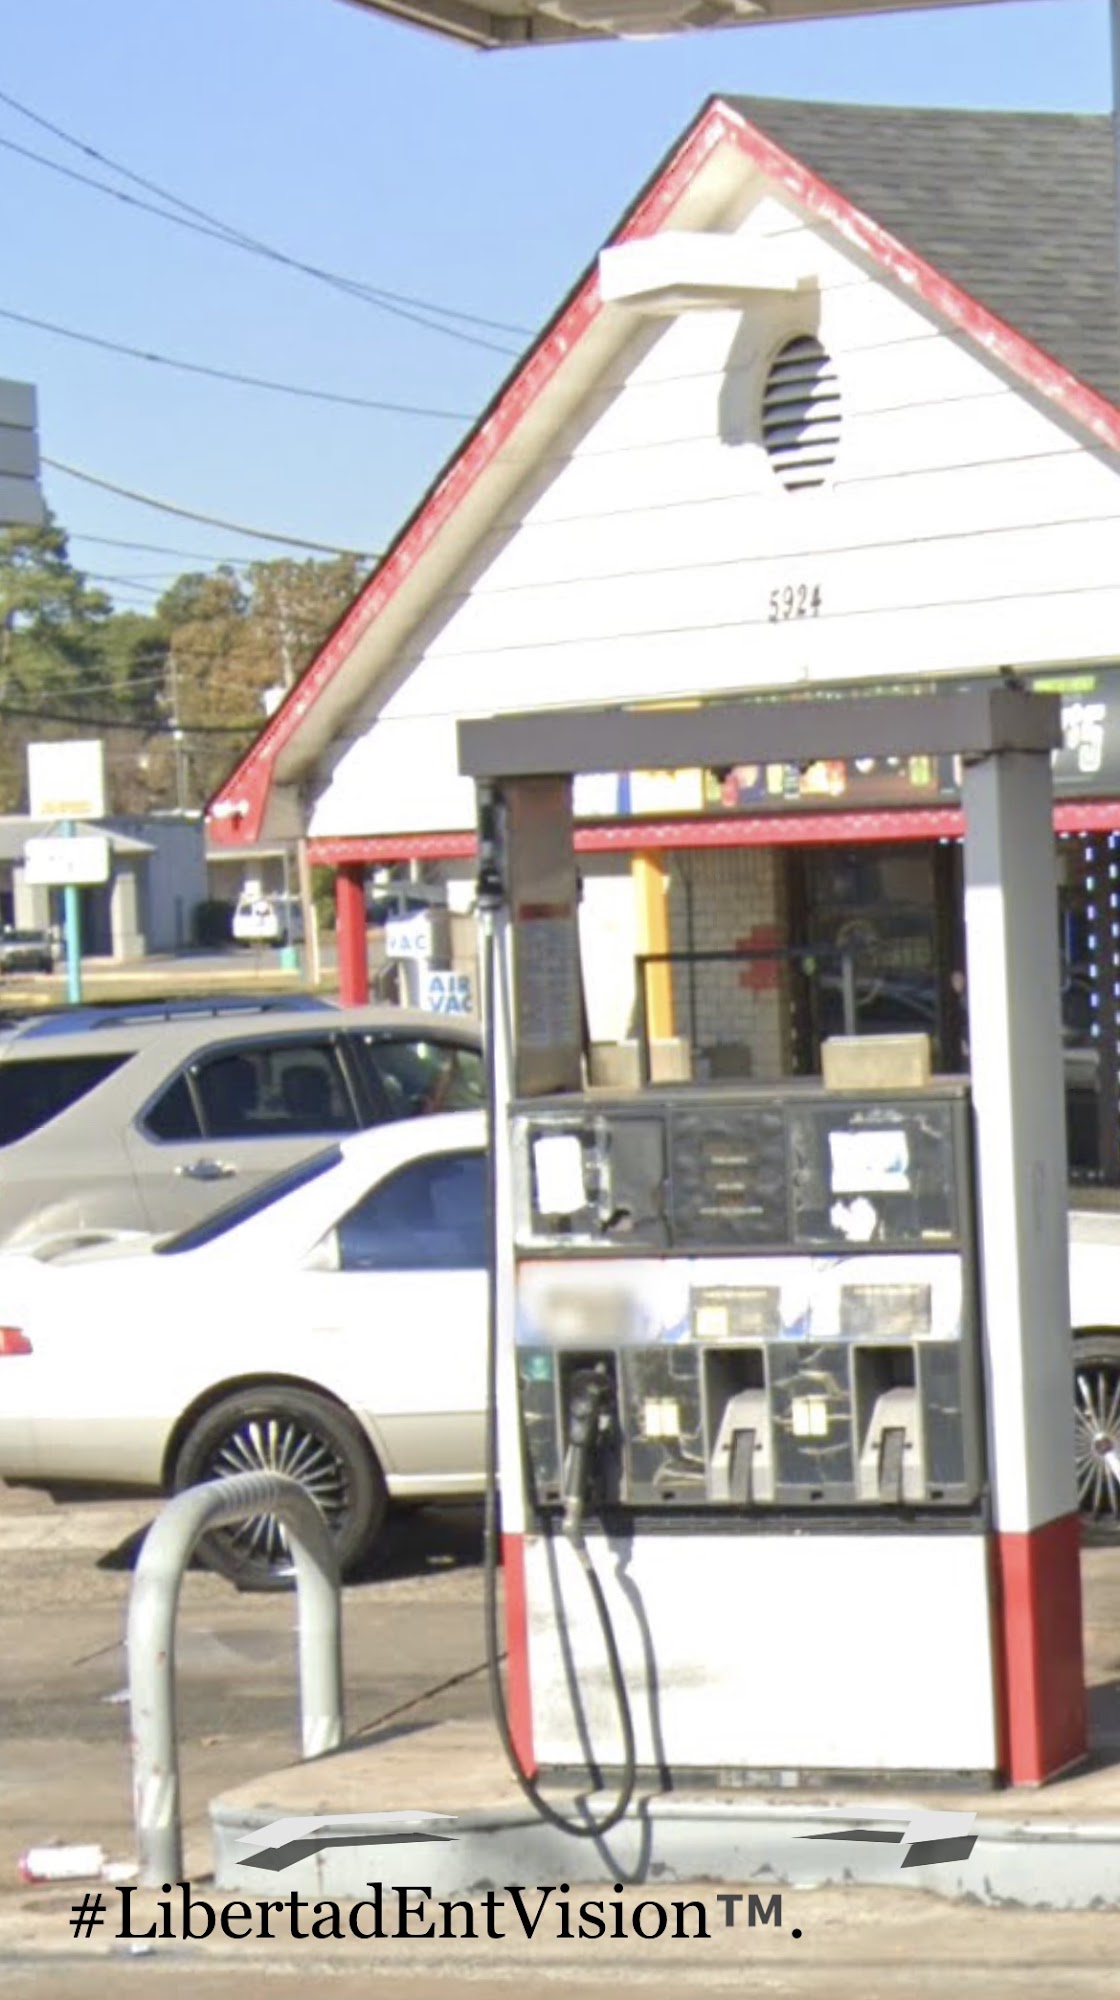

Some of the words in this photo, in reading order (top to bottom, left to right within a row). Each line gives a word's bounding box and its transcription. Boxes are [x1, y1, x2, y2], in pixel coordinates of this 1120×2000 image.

[768, 582, 821, 623] 5924
[388, 934, 427, 951] VAC
[429, 975, 471, 993] AIR
[427, 994, 474, 1014] VAC
